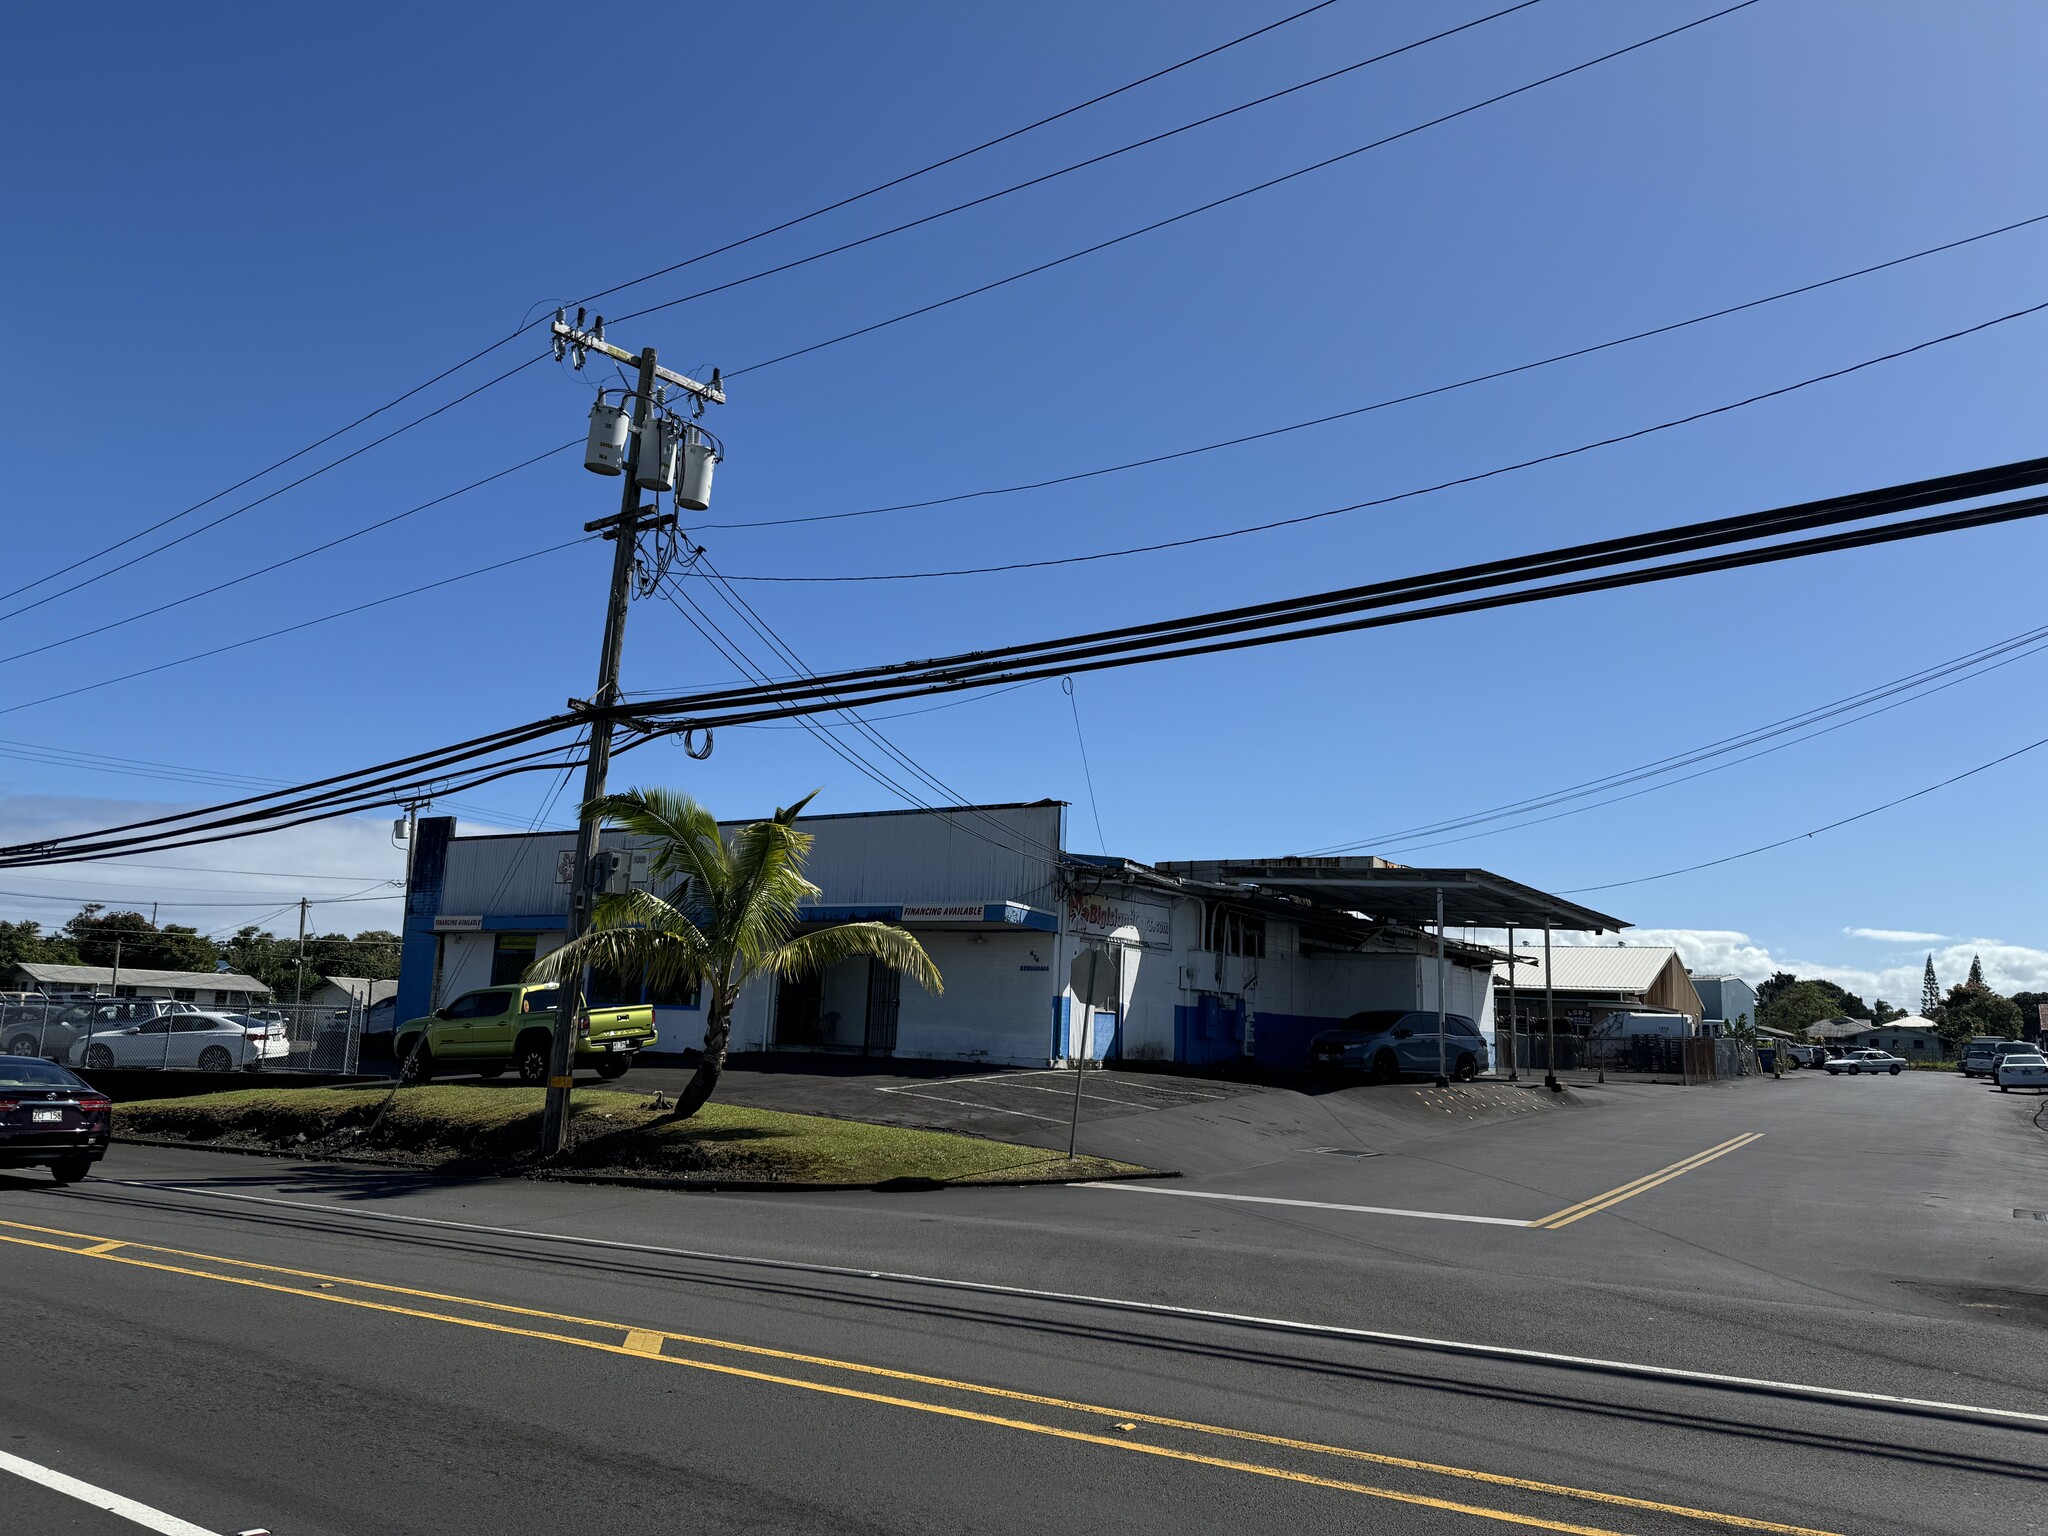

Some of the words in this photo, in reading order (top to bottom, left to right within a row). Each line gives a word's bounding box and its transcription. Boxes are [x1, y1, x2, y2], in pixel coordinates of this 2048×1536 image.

[904, 907, 942, 916] FINANCING
[943, 907, 983, 916] AVAILABLE
[1567, 1009, 1591, 1017] LEO'S
